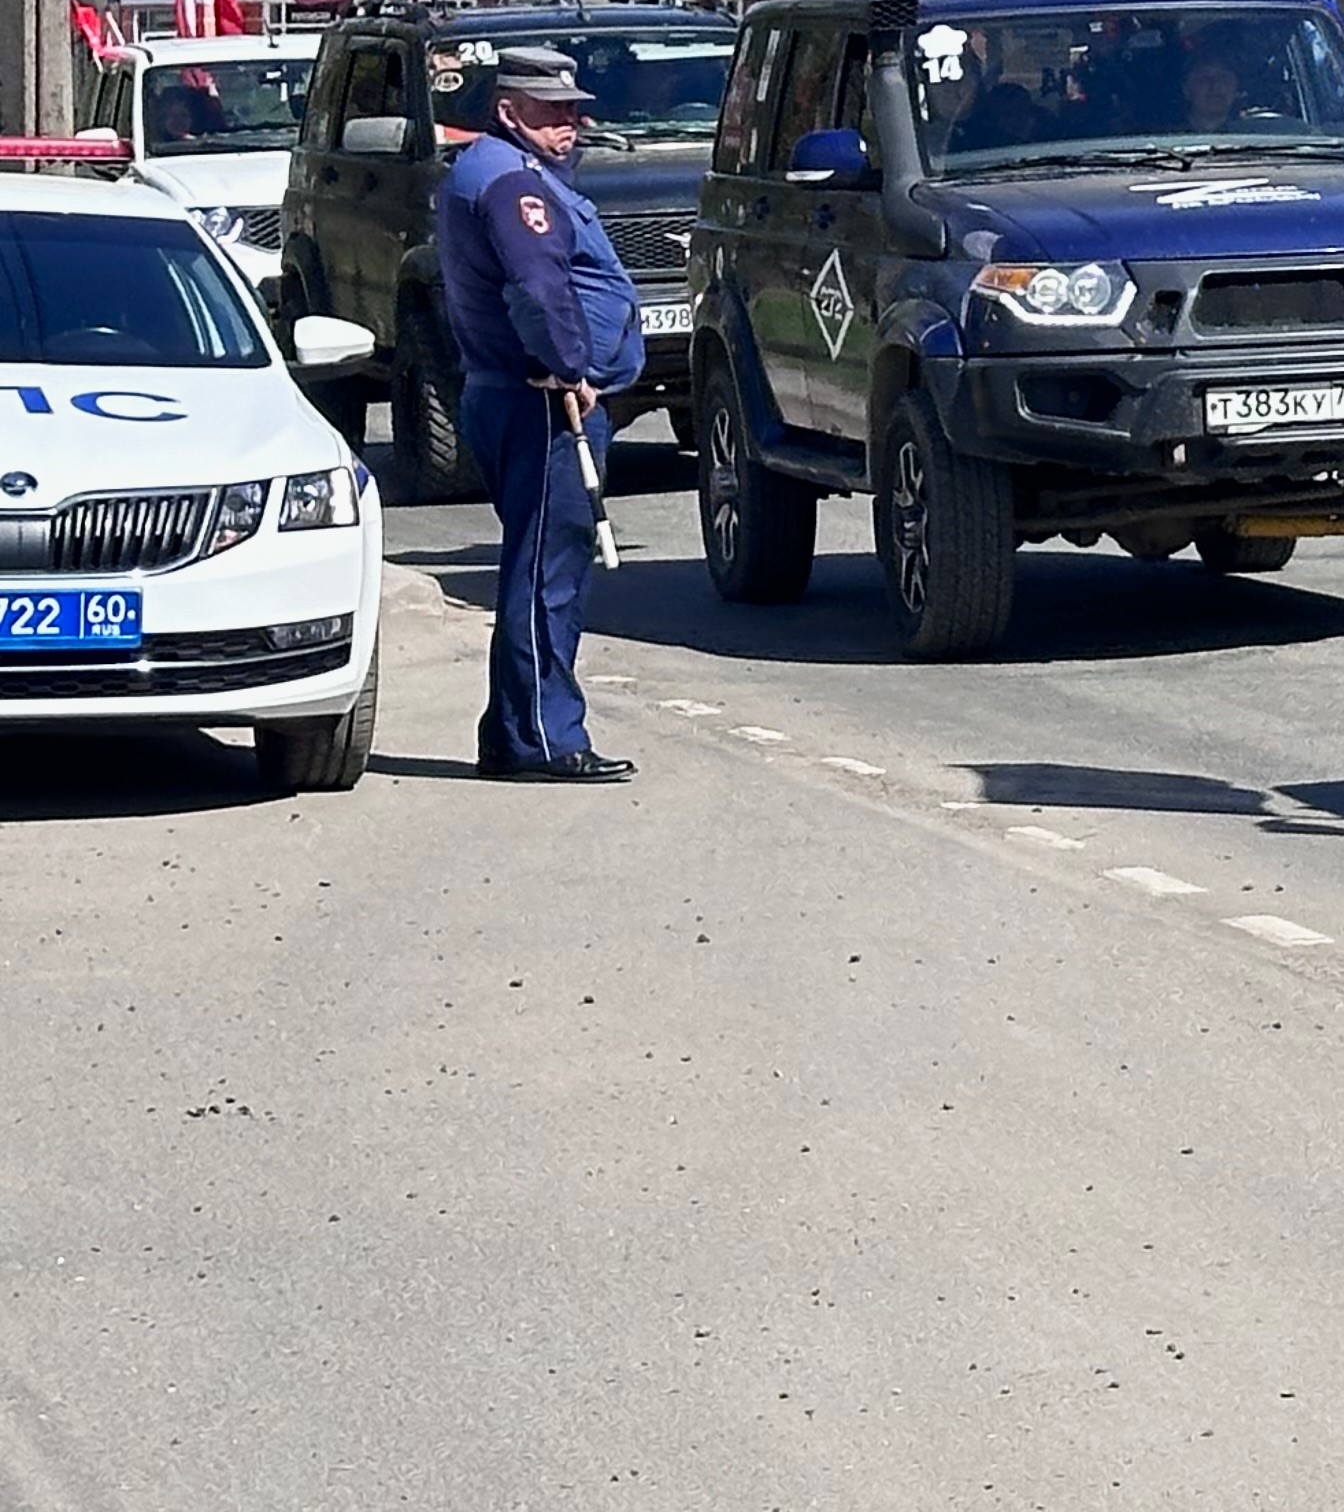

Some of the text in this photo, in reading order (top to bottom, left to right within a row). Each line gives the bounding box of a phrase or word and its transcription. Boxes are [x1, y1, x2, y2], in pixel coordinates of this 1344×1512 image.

[921, 55, 964, 84] 14
[1217, 388, 1327, 421] Т383КУ
[87, 594, 126, 624] 60
